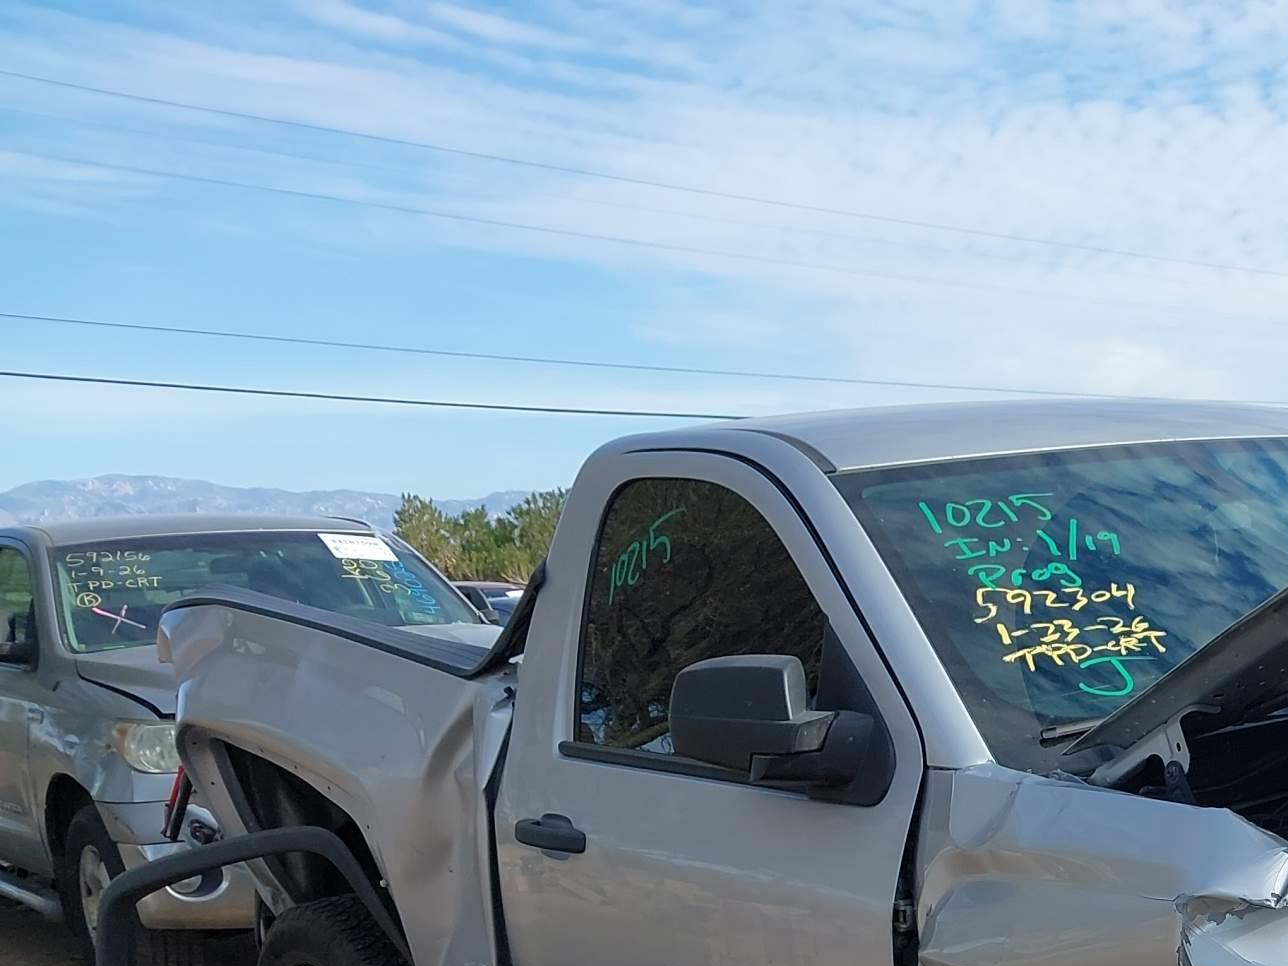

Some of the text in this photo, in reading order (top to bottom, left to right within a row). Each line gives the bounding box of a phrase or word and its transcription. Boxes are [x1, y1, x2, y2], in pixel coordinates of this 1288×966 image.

[919, 493, 1053, 534] 10215
[65, 551, 152, 567] 592156
[608, 507, 687, 606] 10215
[973, 582, 1135, 624] 592304
